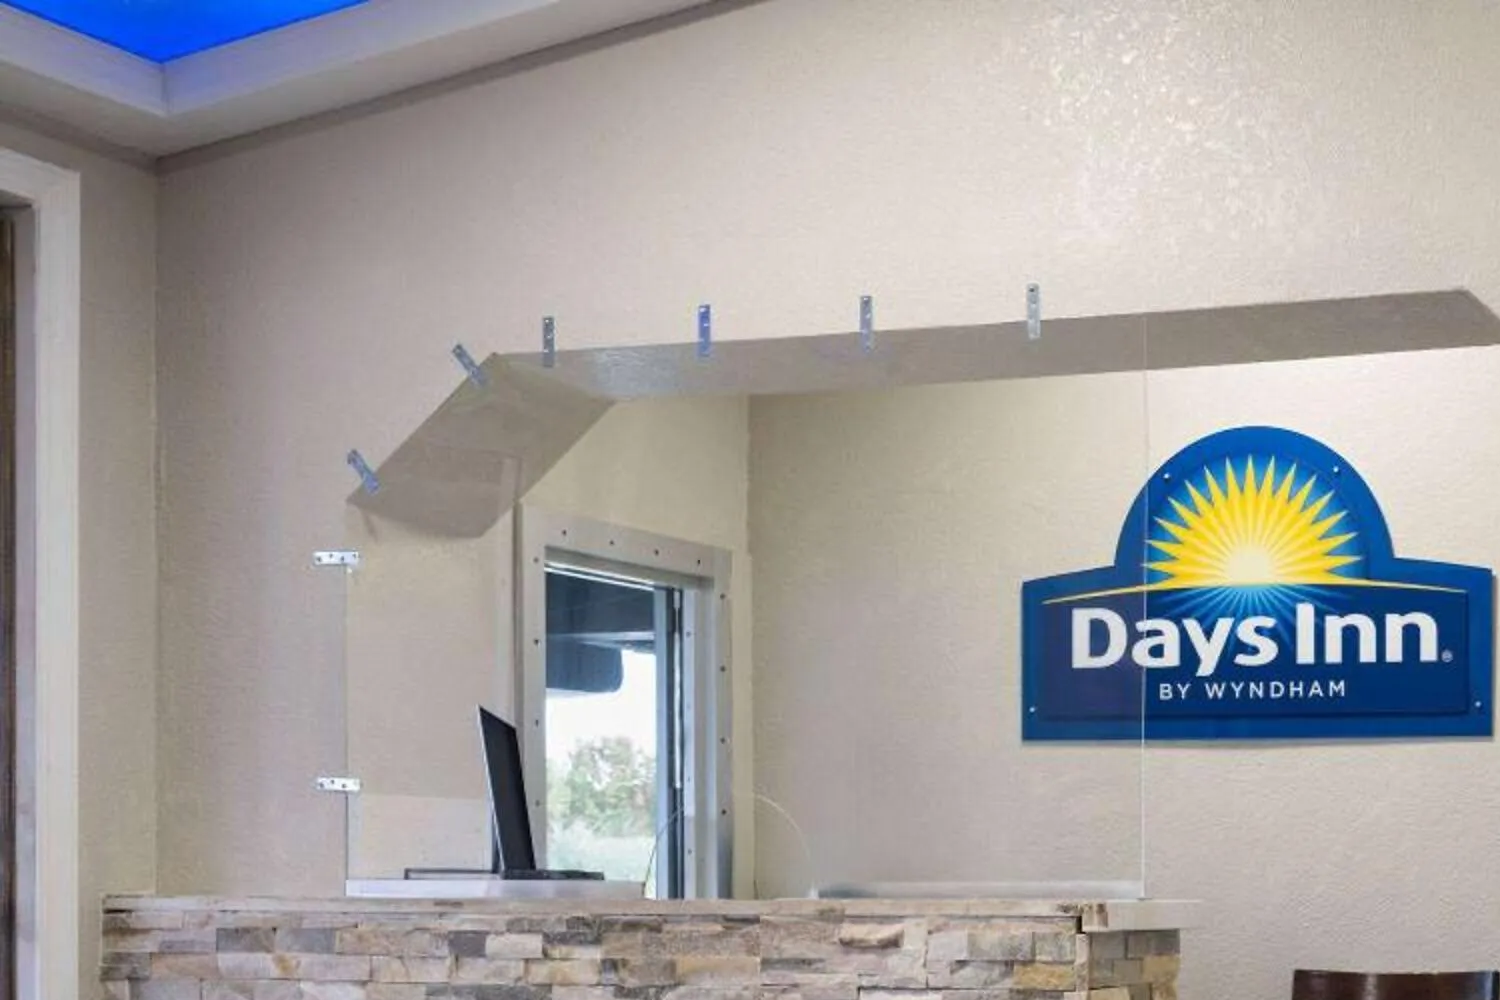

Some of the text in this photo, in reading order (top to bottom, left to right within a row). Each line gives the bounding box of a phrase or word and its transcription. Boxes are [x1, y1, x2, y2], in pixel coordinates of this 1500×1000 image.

[1071, 602, 1439, 677] Days Inn
[1159, 680, 1346, 701] BY WYNDHAM
